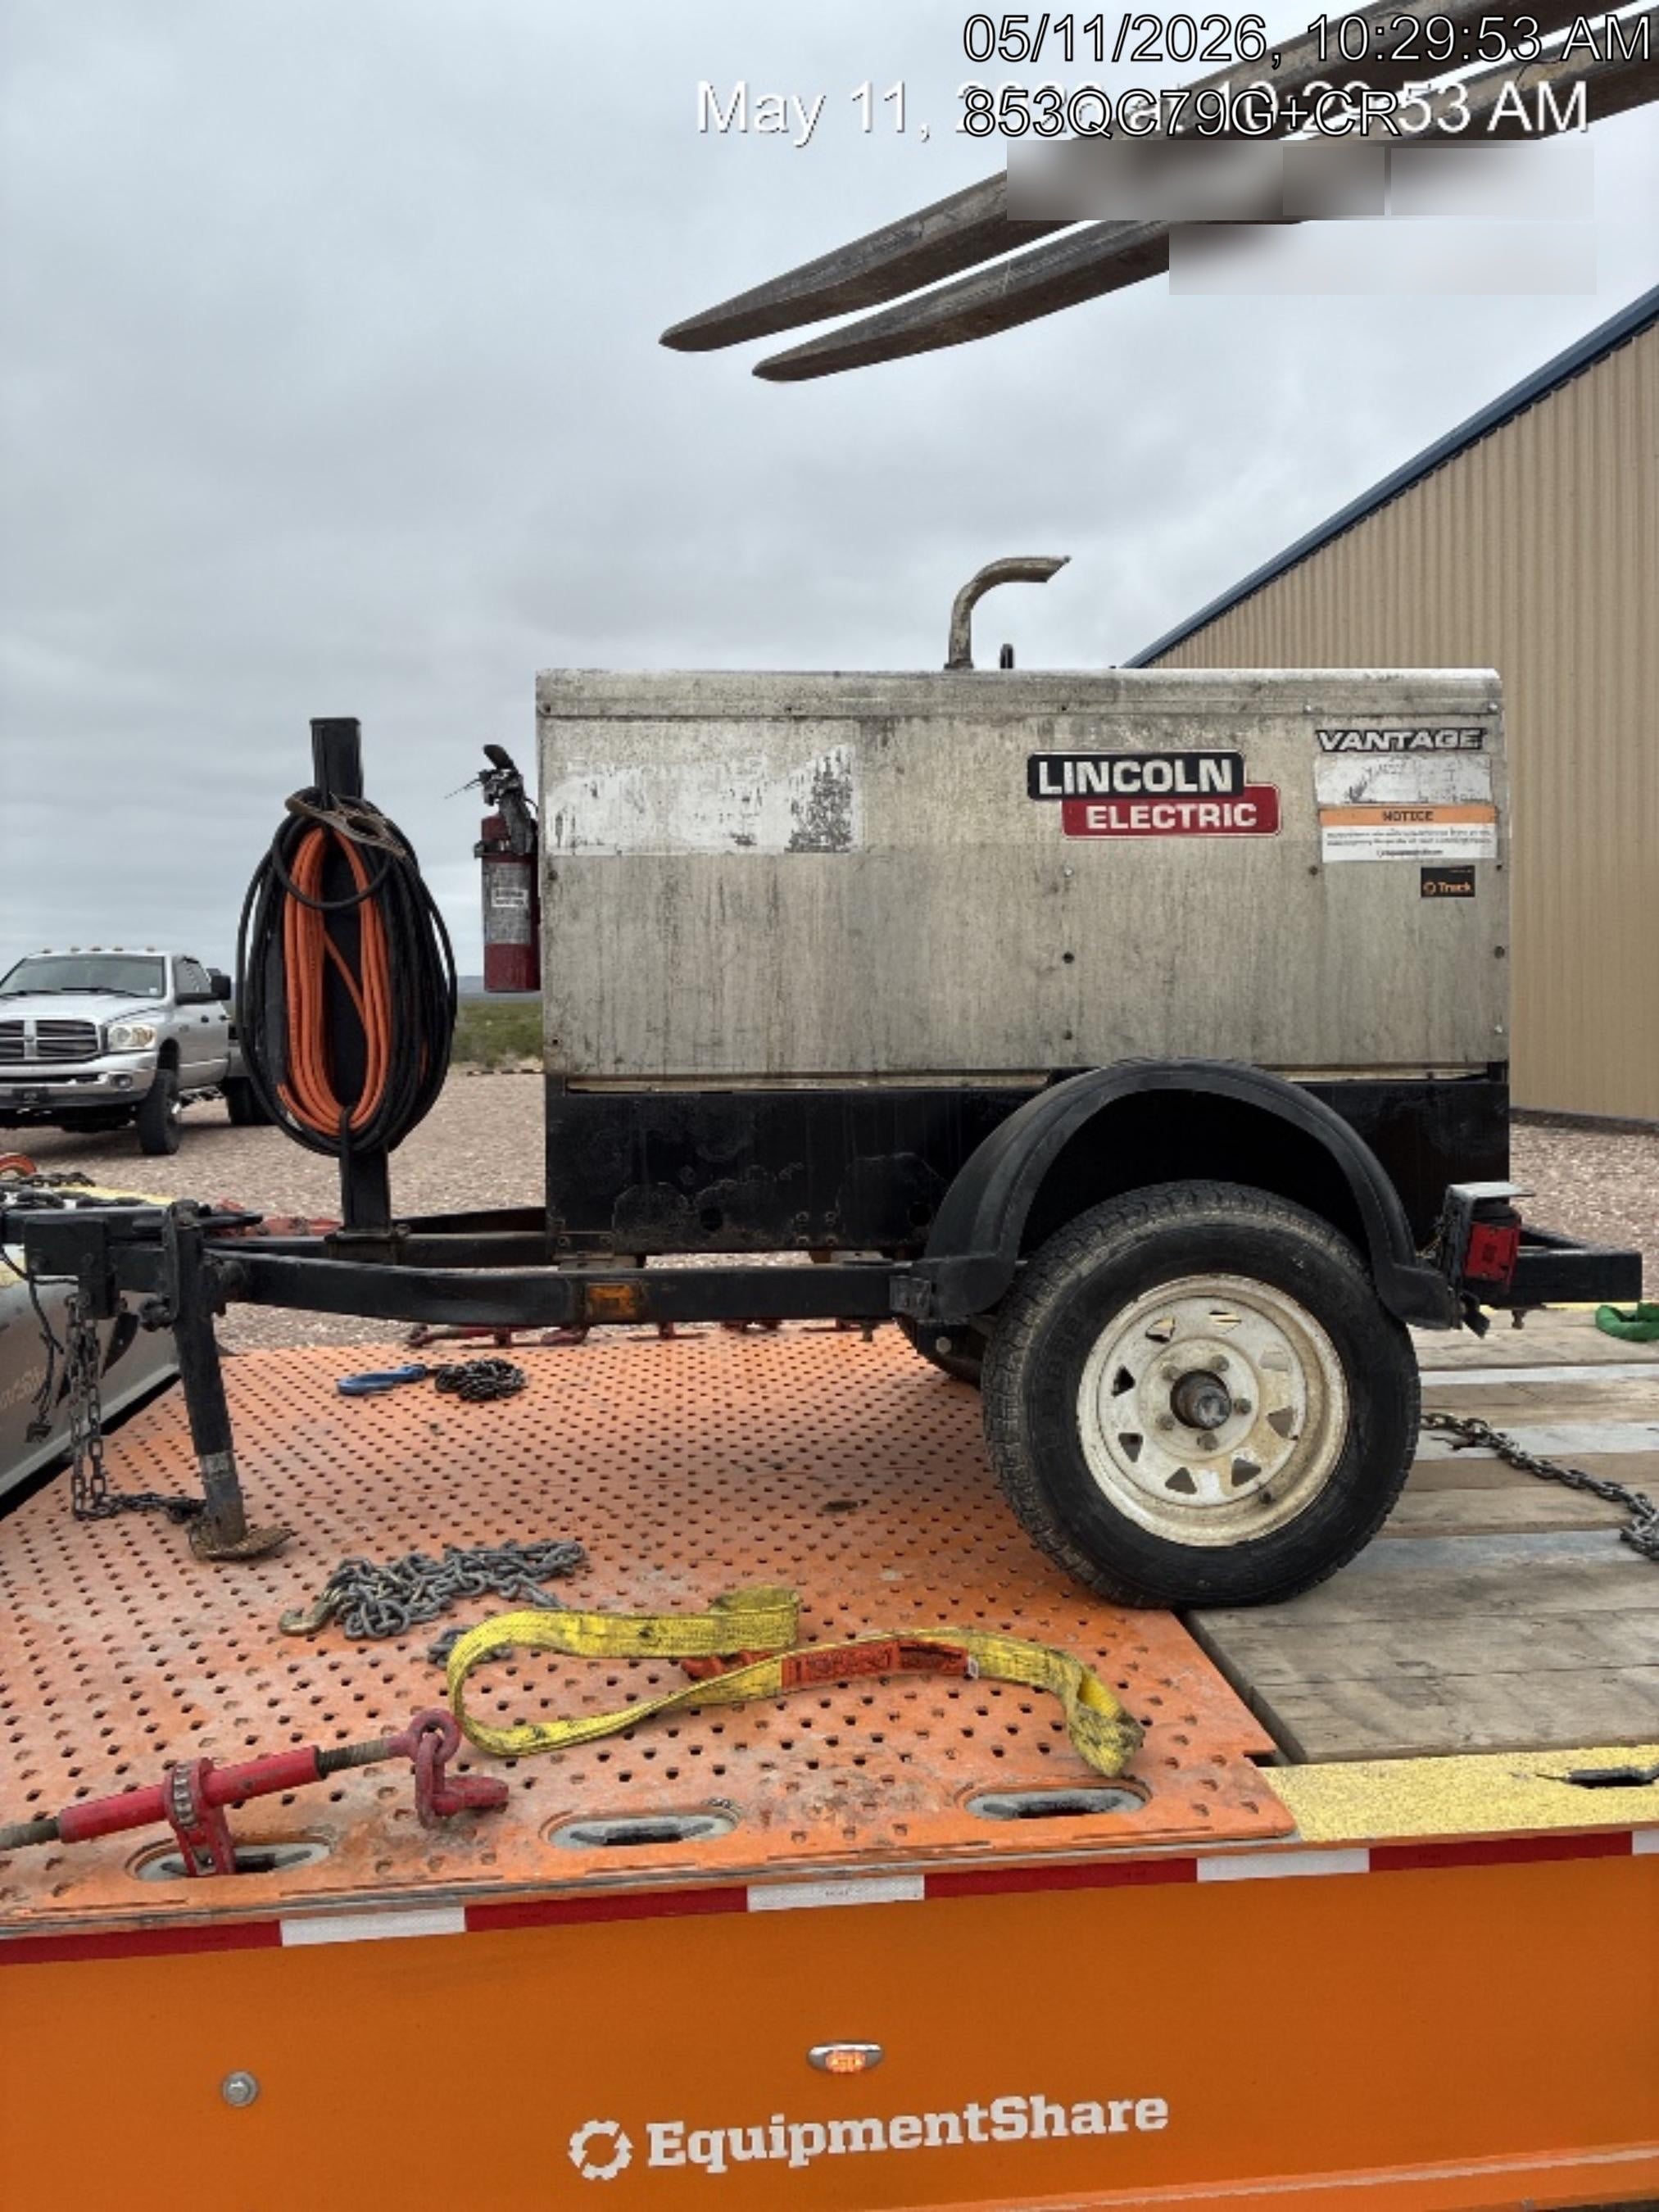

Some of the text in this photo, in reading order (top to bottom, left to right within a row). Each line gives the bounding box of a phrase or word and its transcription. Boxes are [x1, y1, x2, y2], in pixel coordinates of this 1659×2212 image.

[1316, 728, 1487, 752] VANTAGE
[1039, 759, 1233, 795] LINCOLN
[1086, 803, 1258, 829] ELECTRIC
[1382, 810, 1435, 821] NOTICE
[647, 2095, 1169, 2173] EquipmentShare
